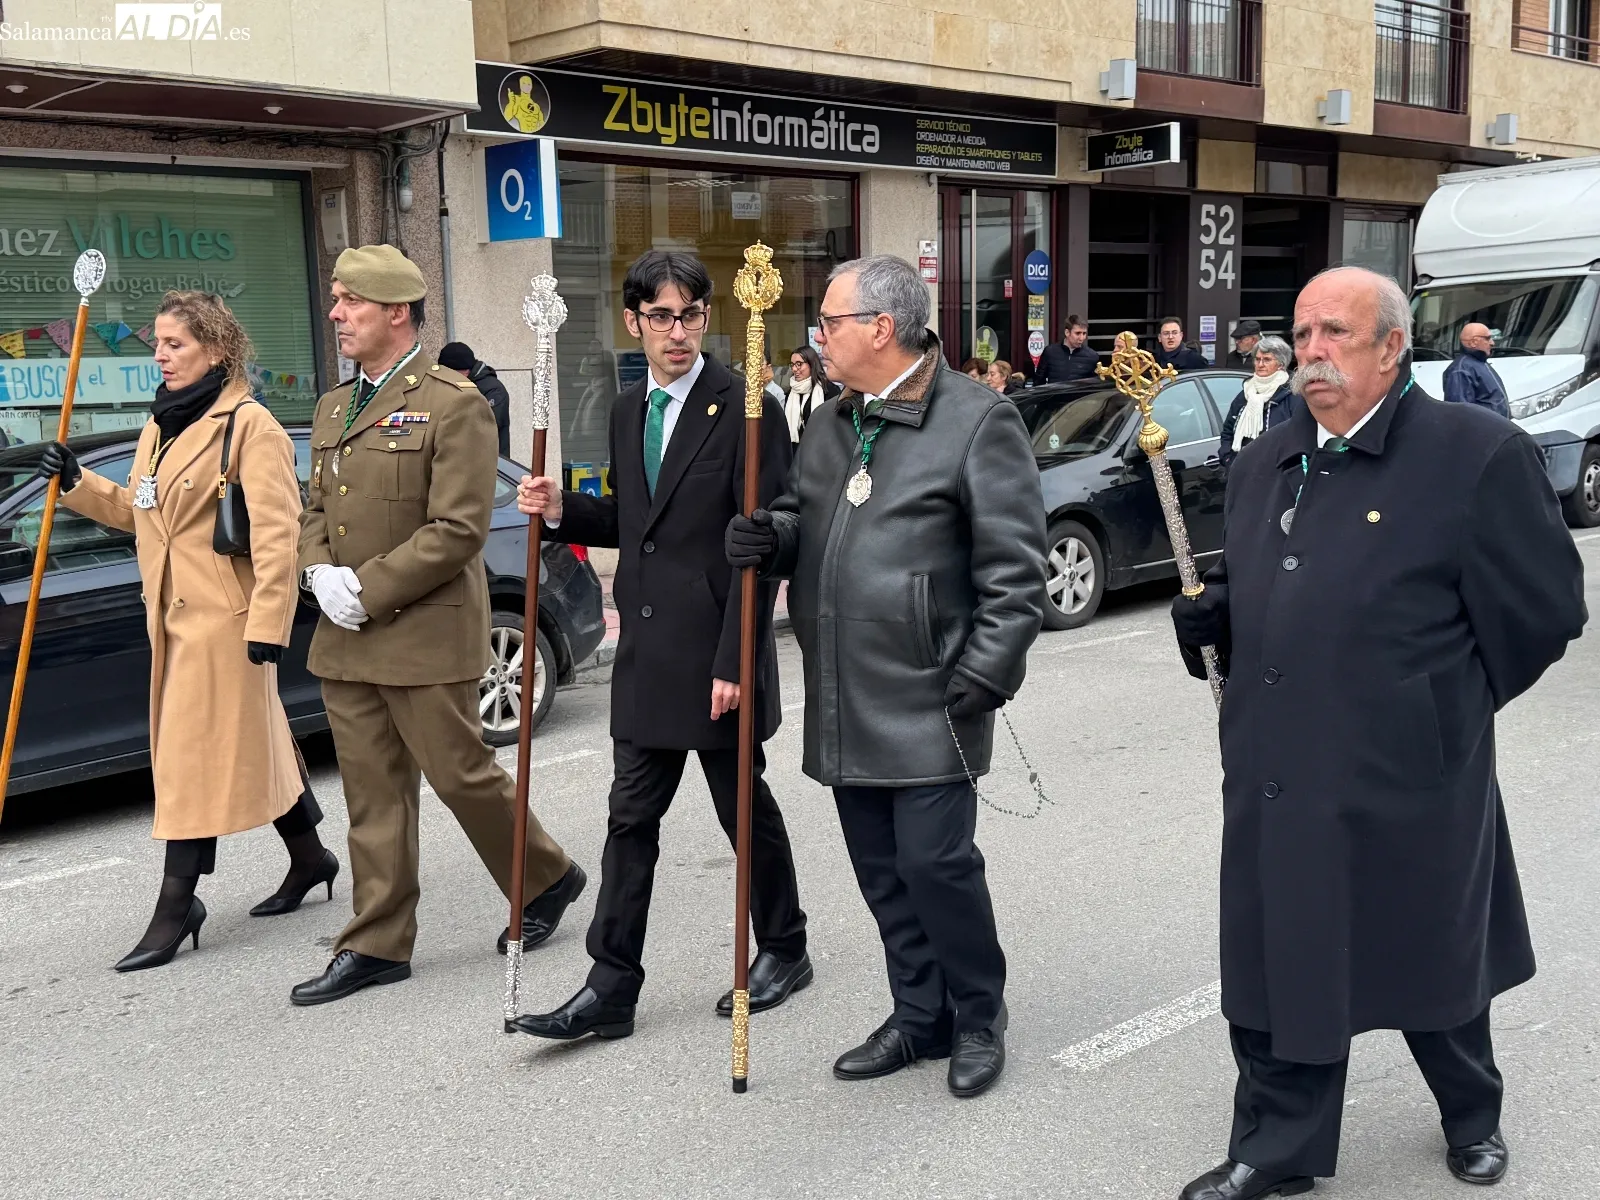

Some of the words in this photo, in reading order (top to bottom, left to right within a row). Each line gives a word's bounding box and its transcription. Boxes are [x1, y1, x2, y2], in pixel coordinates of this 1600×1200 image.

[916, 119, 944, 130] SERVICIO
[945, 120, 971, 133] TÉCNICO
[916, 131, 956, 143] ORDENADOR
[956, 135, 963, 143] A
[963, 136, 987, 146] MEDIDA
[1115, 133, 1143, 150] Zbyte
[916, 143, 956, 156] REPARACIÓN
[956, 147, 965, 156] DE
[966, 147, 1012, 160] SMARTPHONES
[1011, 151, 1017, 160] Y
[1017, 152, 1042, 162] TABLETS
[1104, 148, 1154, 167] informática
[916, 155, 940, 166] DISEÑO
[940, 157, 946, 166] Y
[946, 158, 996, 170] MANTENIMIENTO
[996, 161, 1011, 171] WEB
[1199, 204, 1235, 245] 52
[66, 212, 236, 260] Vilches
[1027, 264, 1049, 276] DIGI
[1198, 249, 1236, 290] 54
[89, 371, 106, 386] el
